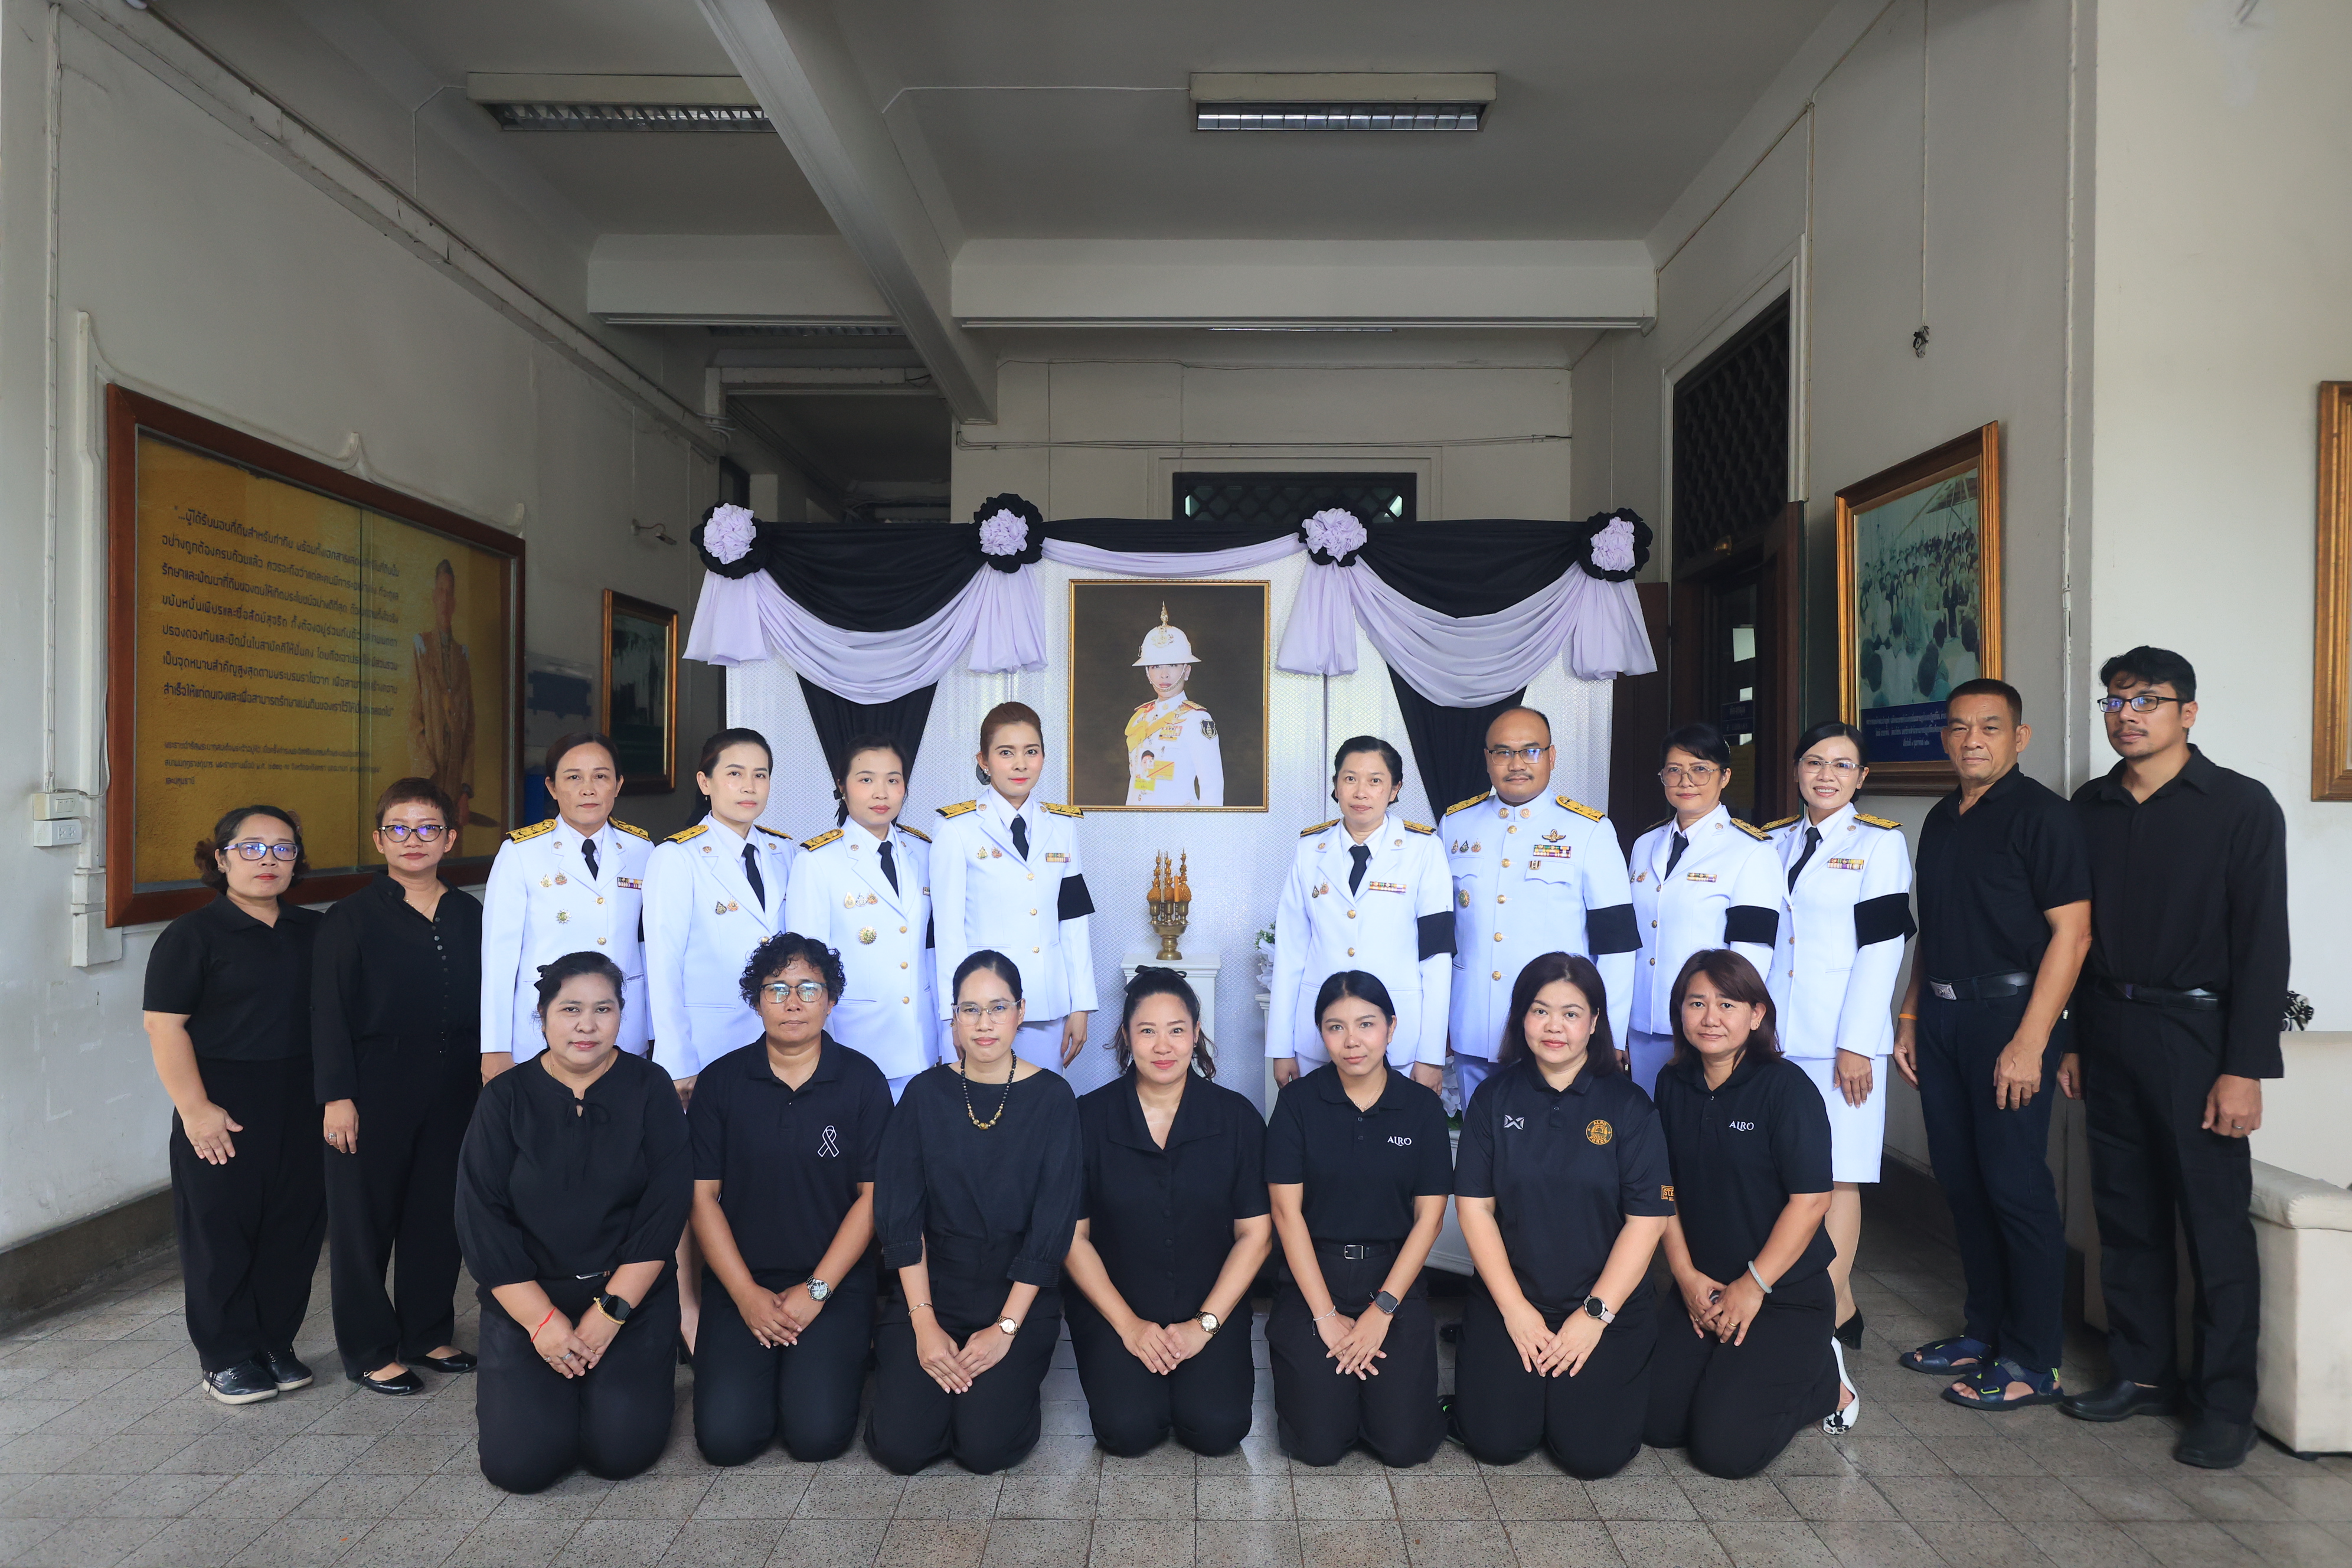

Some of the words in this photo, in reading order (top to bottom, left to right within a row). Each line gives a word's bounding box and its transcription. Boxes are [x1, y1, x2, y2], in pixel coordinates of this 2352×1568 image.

[162, 533, 263, 568] อย่างถูกต้องครบถ้วนแล้ว
[1729, 1121, 1754, 1132] ALRO
[1387, 1135, 1412, 1146] ALRO
